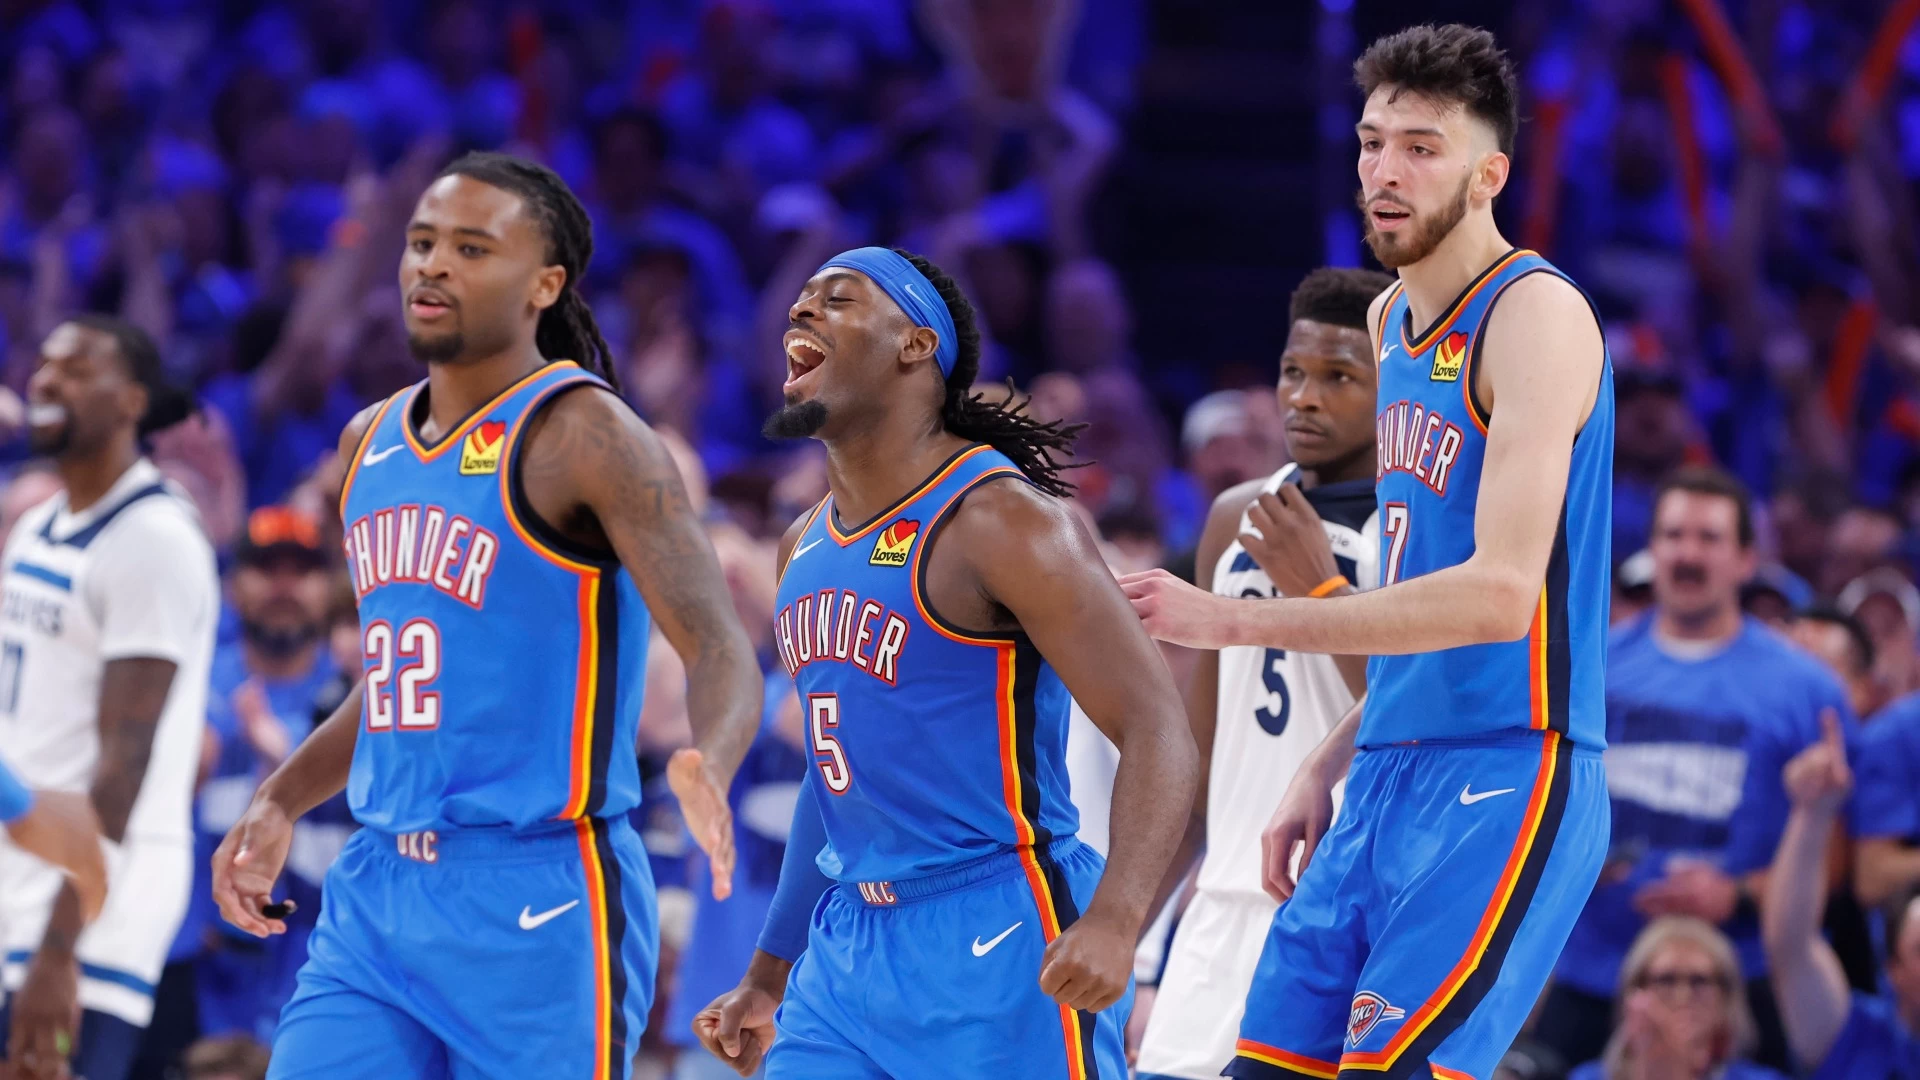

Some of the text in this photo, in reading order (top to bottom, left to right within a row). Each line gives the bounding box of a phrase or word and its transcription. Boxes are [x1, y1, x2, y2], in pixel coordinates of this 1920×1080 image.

[1433, 363, 1459, 378] Love's
[1376, 400, 1464, 497] HUNDER
[343, 503, 499, 611] HUNDER
[872, 547, 906, 563] Love's
[1384, 502, 1409, 586] 7
[365, 617, 442, 733] 22
[775, 588, 910, 687] HUNDER
[1255, 648, 1290, 736] 5
[807, 692, 852, 796] 5
